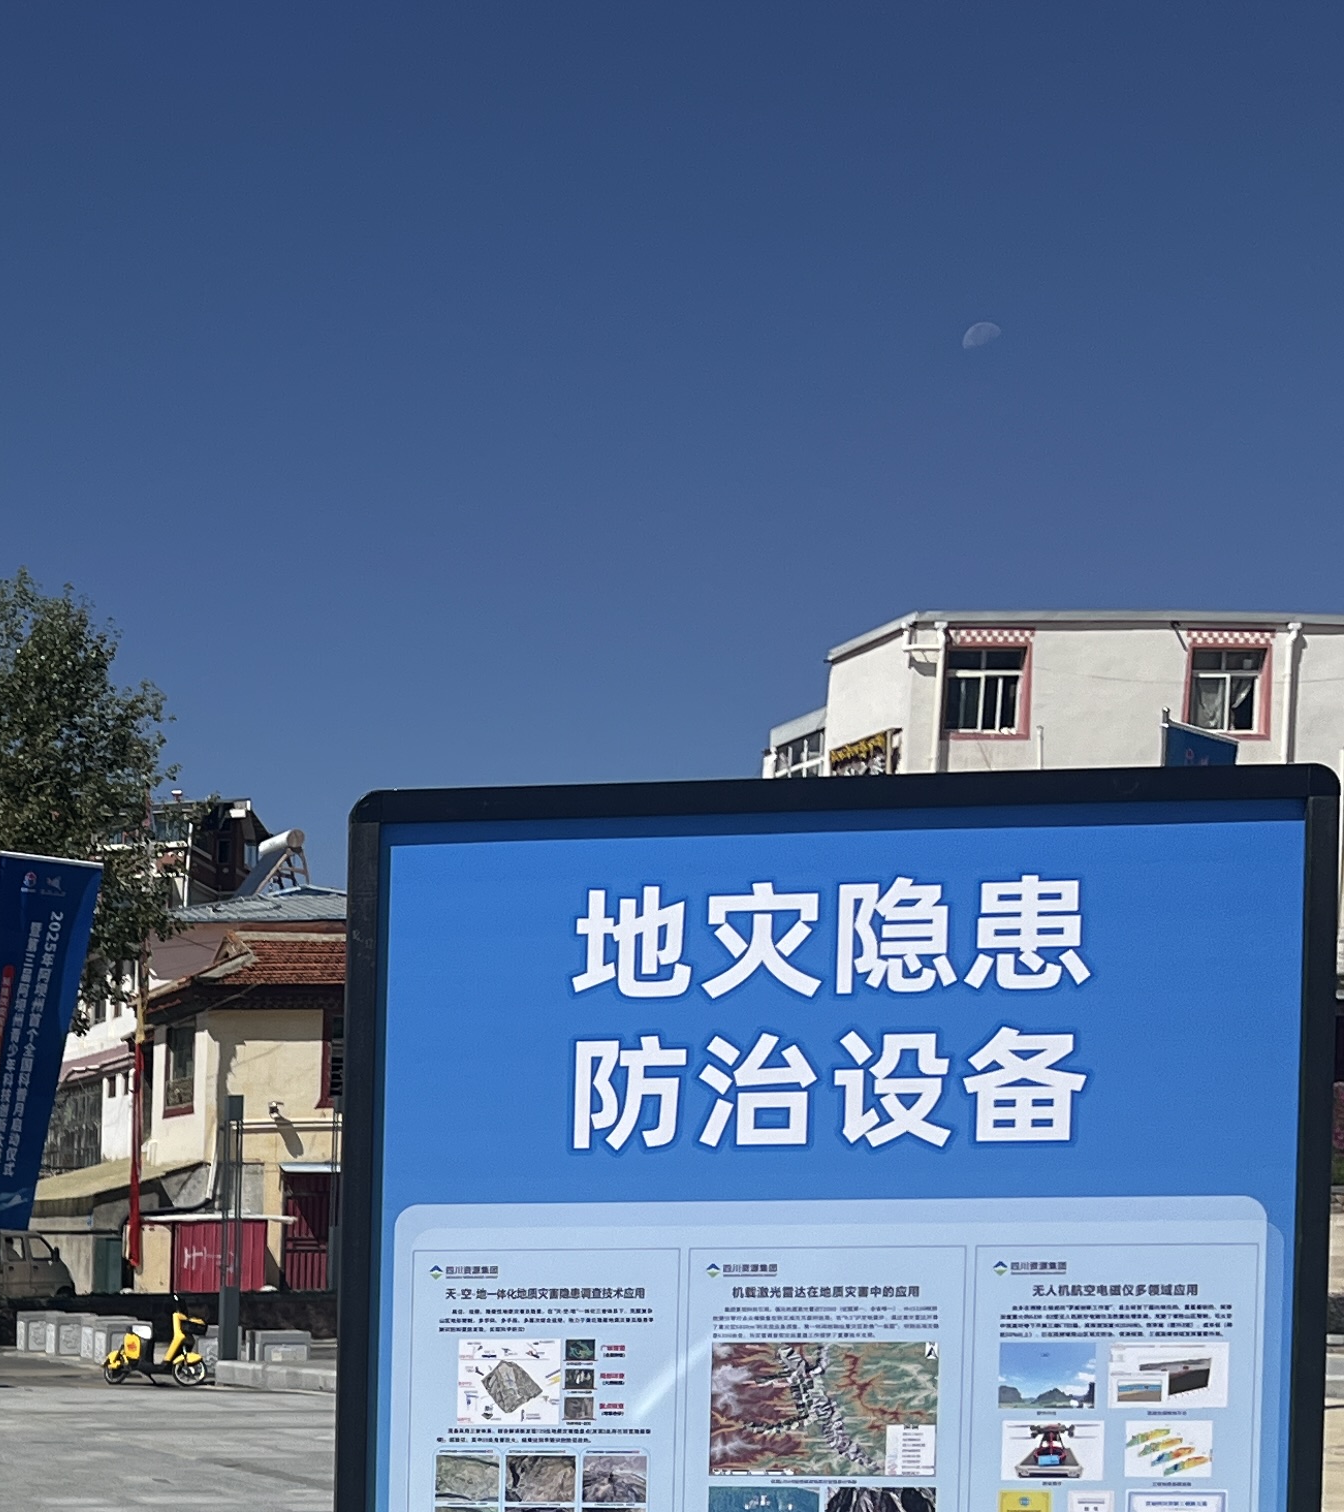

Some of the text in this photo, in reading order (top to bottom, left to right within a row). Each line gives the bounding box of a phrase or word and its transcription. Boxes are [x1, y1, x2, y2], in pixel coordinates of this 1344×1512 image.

[569, 874, 1092, 1001] 地灾隐患
[570, 1026, 1088, 1152] 防治设备
